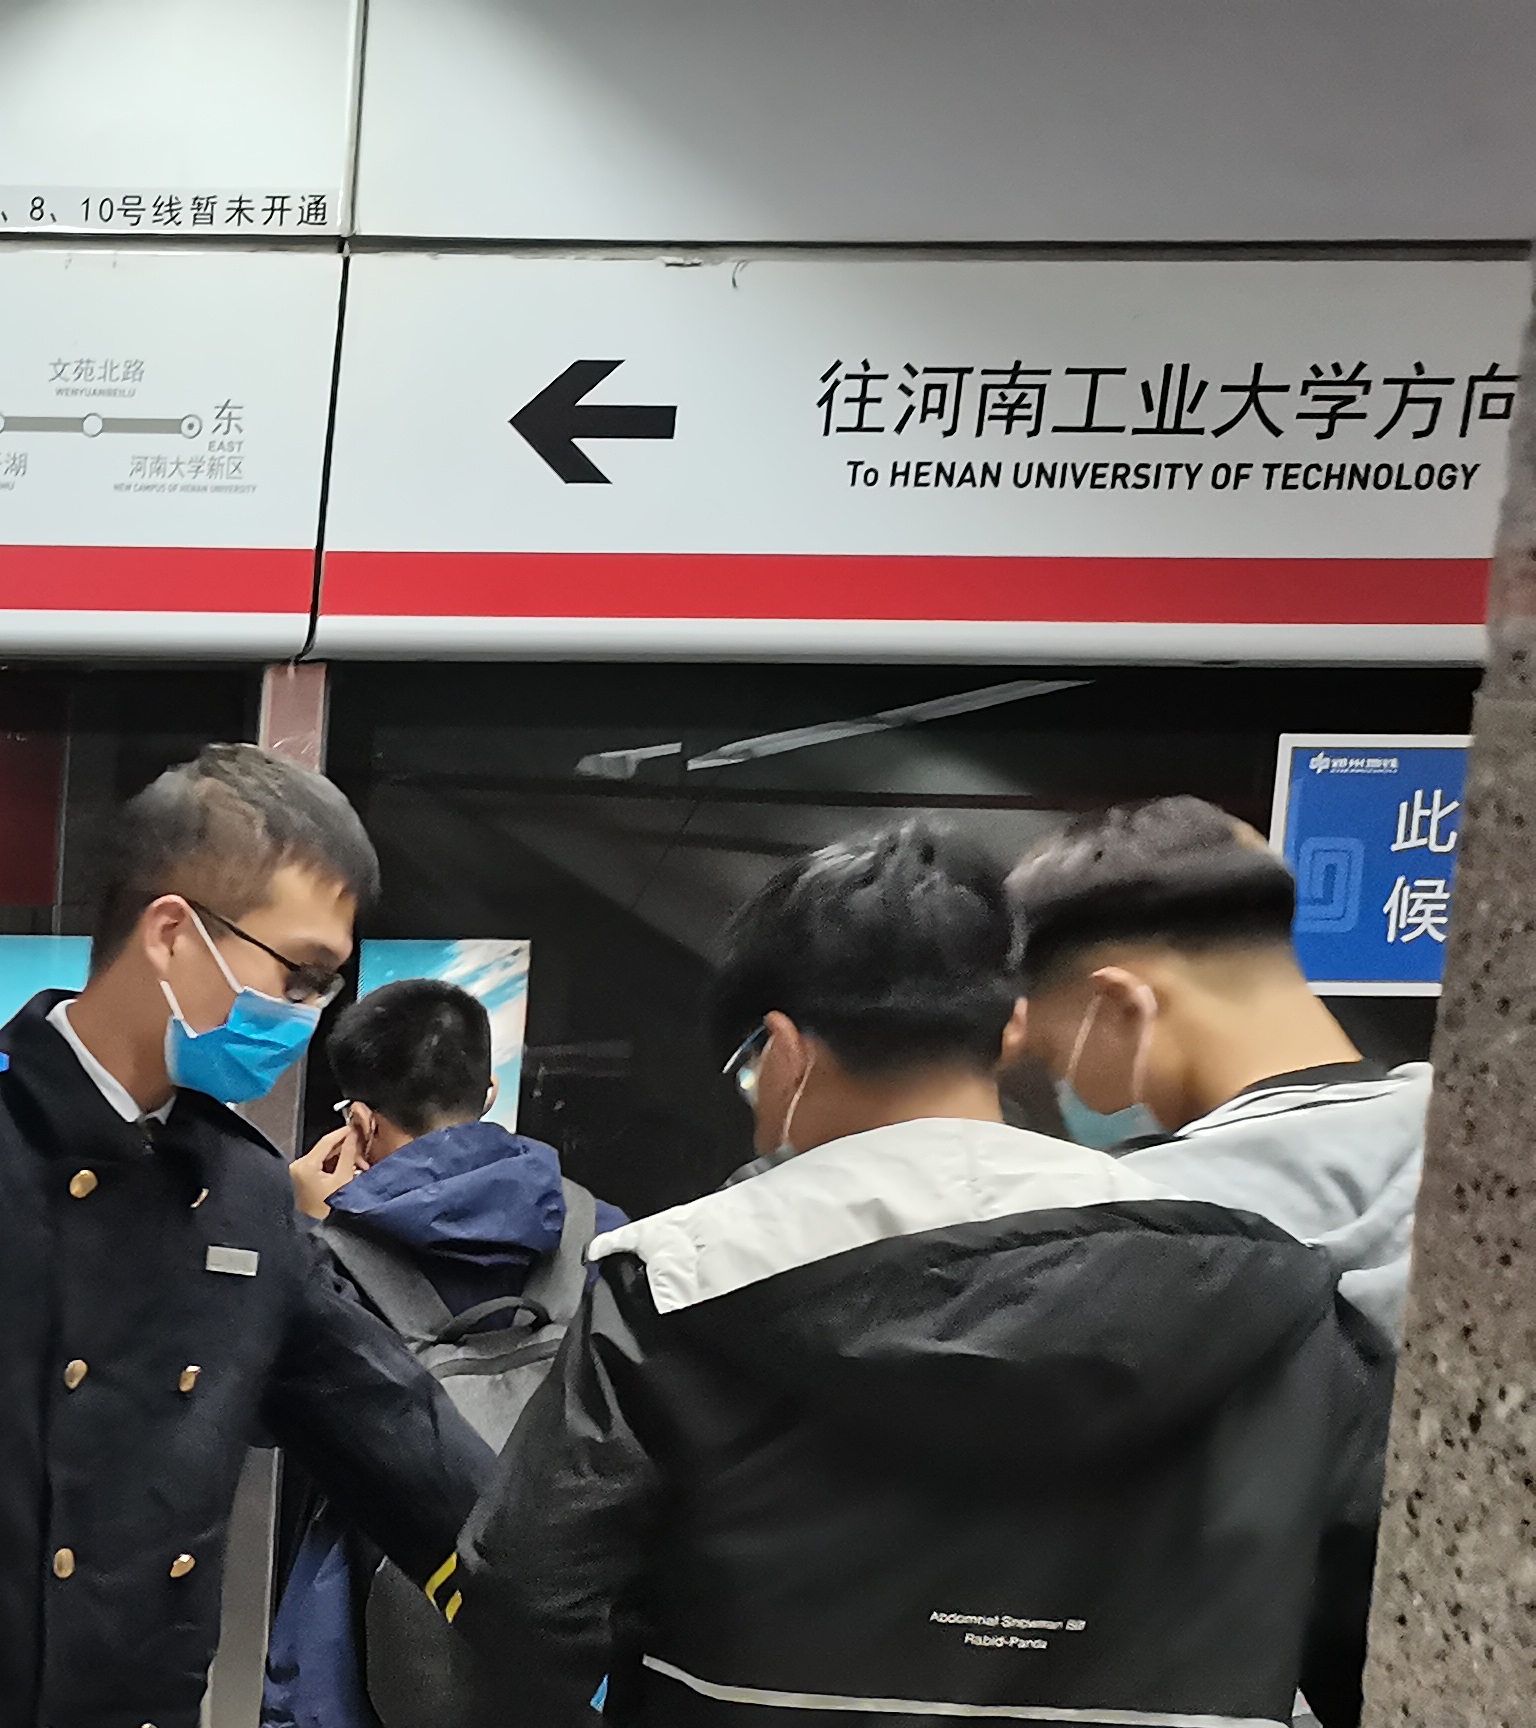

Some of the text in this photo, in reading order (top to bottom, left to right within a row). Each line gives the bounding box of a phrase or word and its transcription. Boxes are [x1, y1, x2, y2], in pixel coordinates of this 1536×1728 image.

[48, 357, 145, 383] 文苑北路
[212, 398, 244, 436] 东
[816, 360, 1521, 440] 往河南工业大学方向
[208, 440, 244, 453] EAST
[129, 454, 245, 480] 河南大学新区
[847, 460, 1480, 491] To HENAN UNIVERSITY OF TECHNOLOGY
[1390, 788, 1460, 853] 此
[1382, 875, 1451, 944] 候
